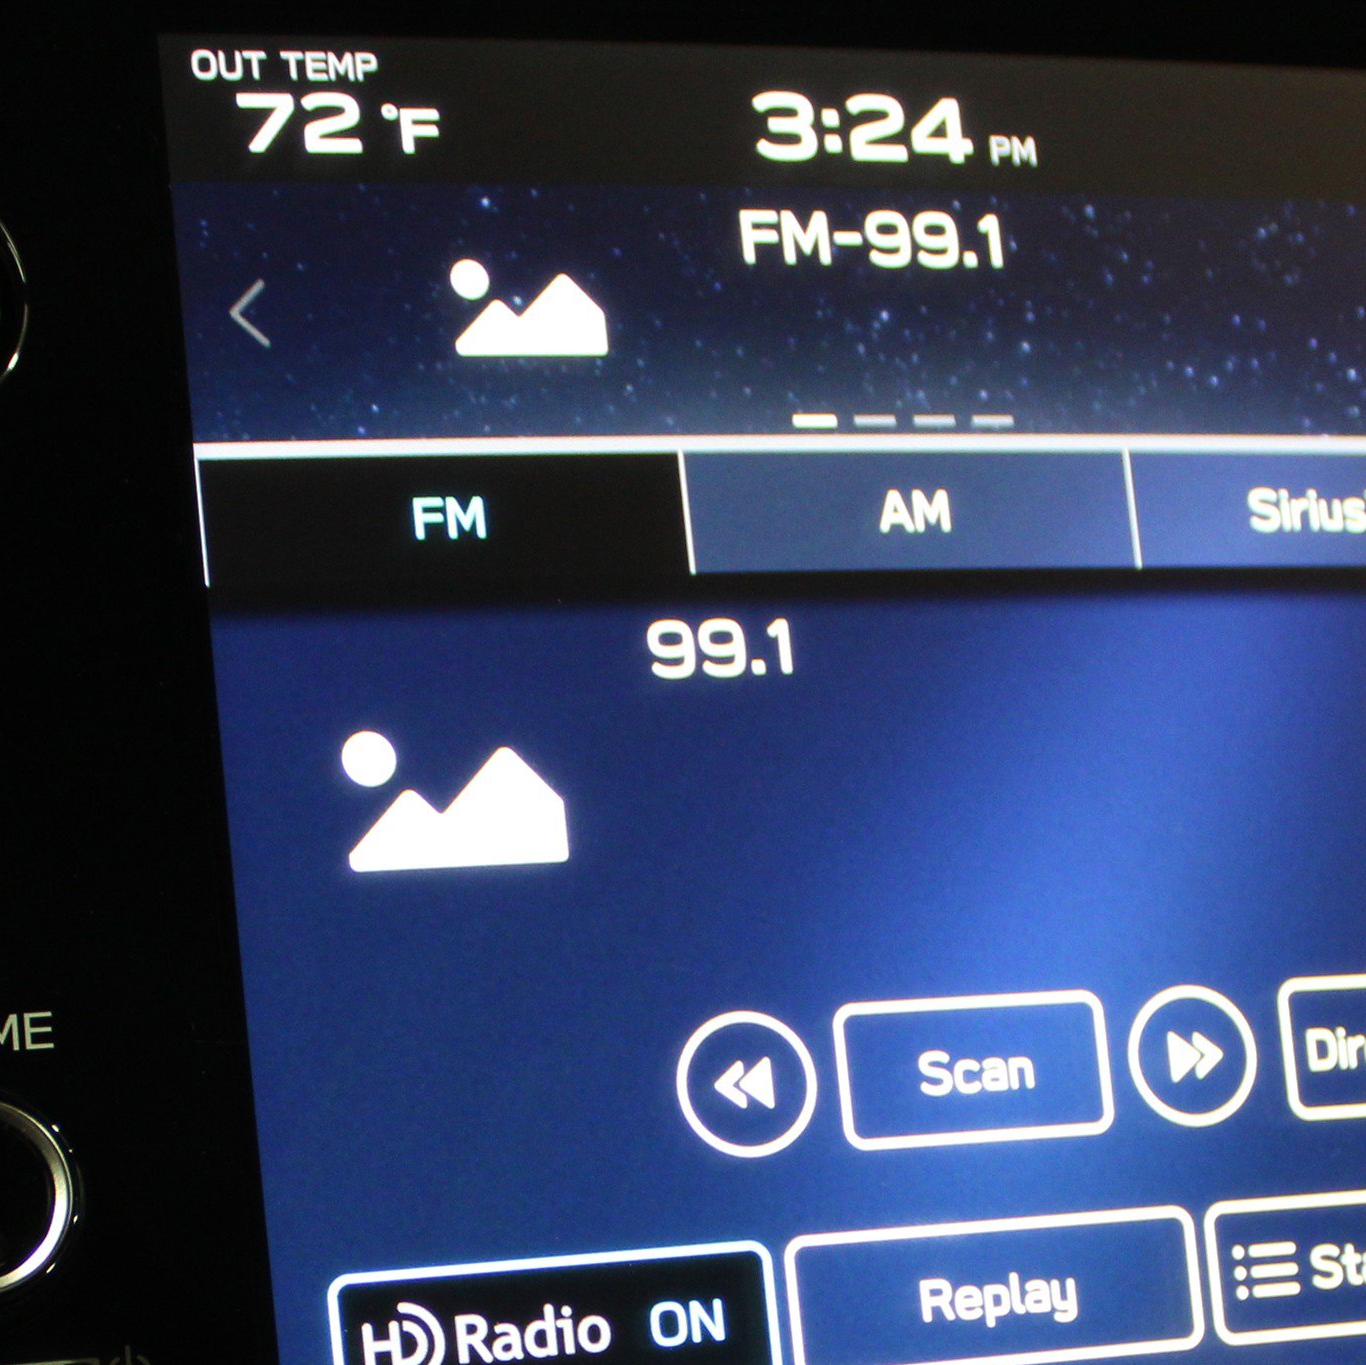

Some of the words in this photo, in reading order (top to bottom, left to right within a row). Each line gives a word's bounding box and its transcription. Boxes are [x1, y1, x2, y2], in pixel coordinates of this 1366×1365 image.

[191, 50, 266, 81] OUT
[280, 50, 378, 83] TEMP
[235, 92, 363, 154] 72
[752, 91, 973, 164] 3:24
[989, 135, 1037, 167] PM
[739, 209, 1005, 269] FM-99.1
[412, 497, 487, 540] FM
[879, 489, 952, 533] AM
[647, 618, 794, 680] 99.1
[918, 1049, 1035, 1097] Scan
[919, 1273, 1079, 1327] Replay
[454, 1304, 612, 1365] Radio
[649, 1298, 726, 1349] ON
